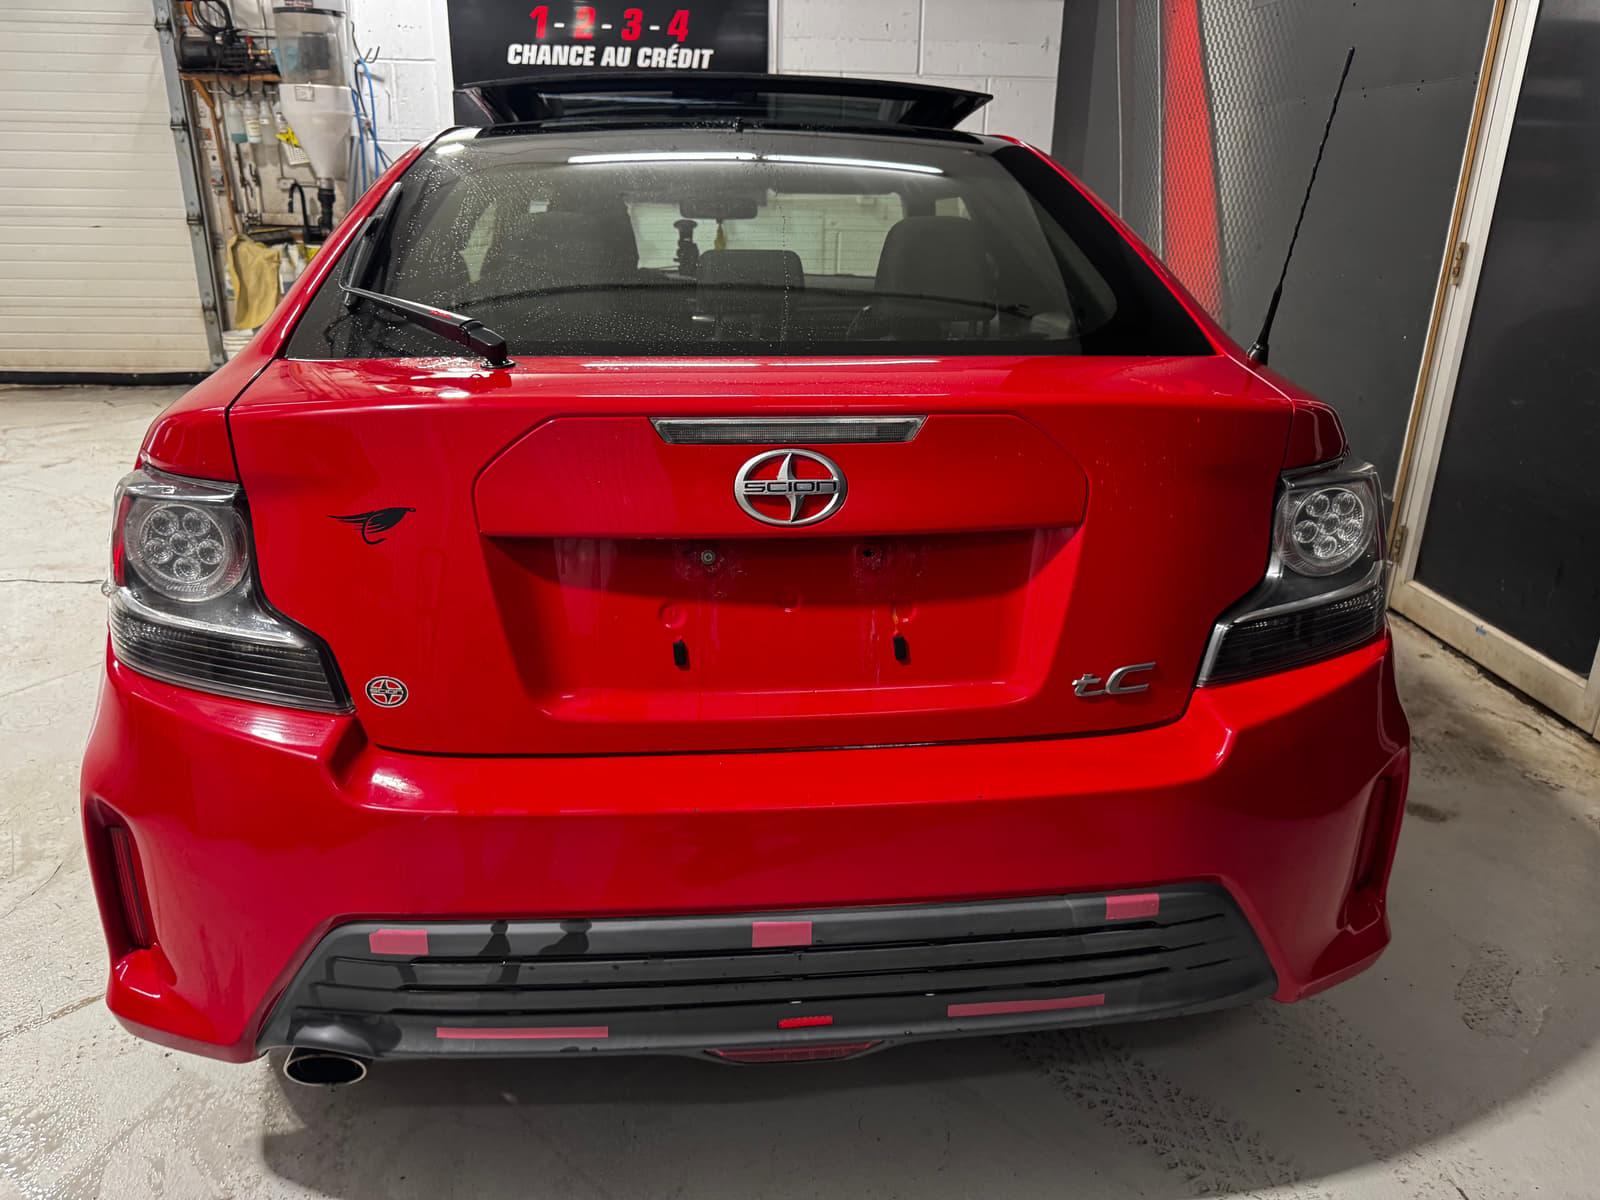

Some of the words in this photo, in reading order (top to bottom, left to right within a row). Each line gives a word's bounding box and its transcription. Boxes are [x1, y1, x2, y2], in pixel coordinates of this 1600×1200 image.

[507, 44, 596, 67] CHANCE
[600, 46, 632, 67] AU
[637, 44, 714, 69] CRÉDIT
[743, 480, 838, 494] SCION
[1072, 661, 1156, 697] tC
